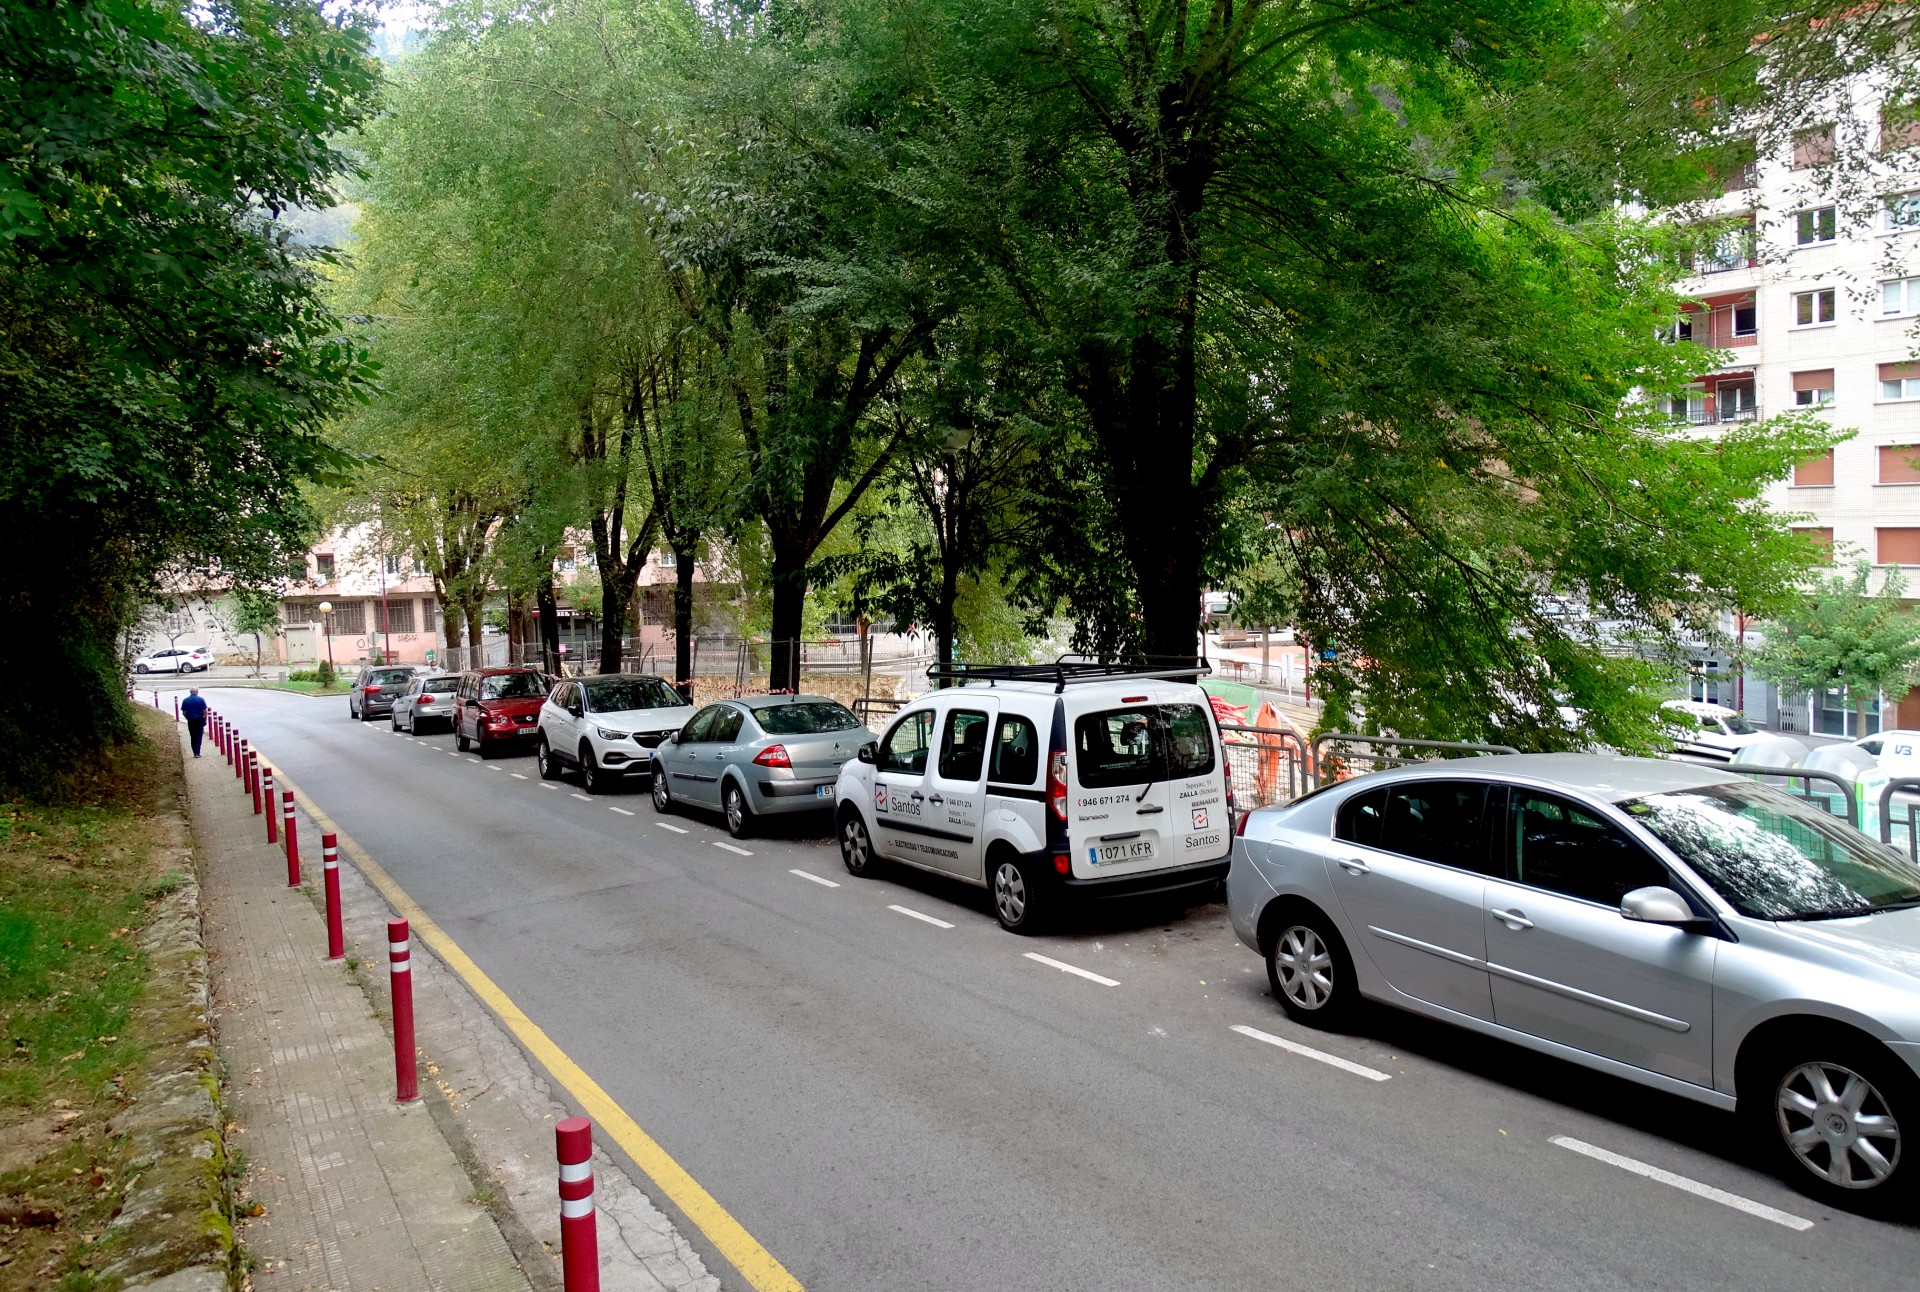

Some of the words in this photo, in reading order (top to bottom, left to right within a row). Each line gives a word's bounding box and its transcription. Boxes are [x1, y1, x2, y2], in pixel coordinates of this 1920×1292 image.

[1083, 798, 1097, 807] 946
[1100, 796, 1113, 805] 671
[1116, 795, 1130, 803] 274
[1179, 790, 1198, 799] ZALLA
[891, 797, 920, 816] Santos
[1185, 834, 1220, 848] Santos
[1100, 846, 1126, 860] 1071
[1130, 842, 1152, 856] KFR
